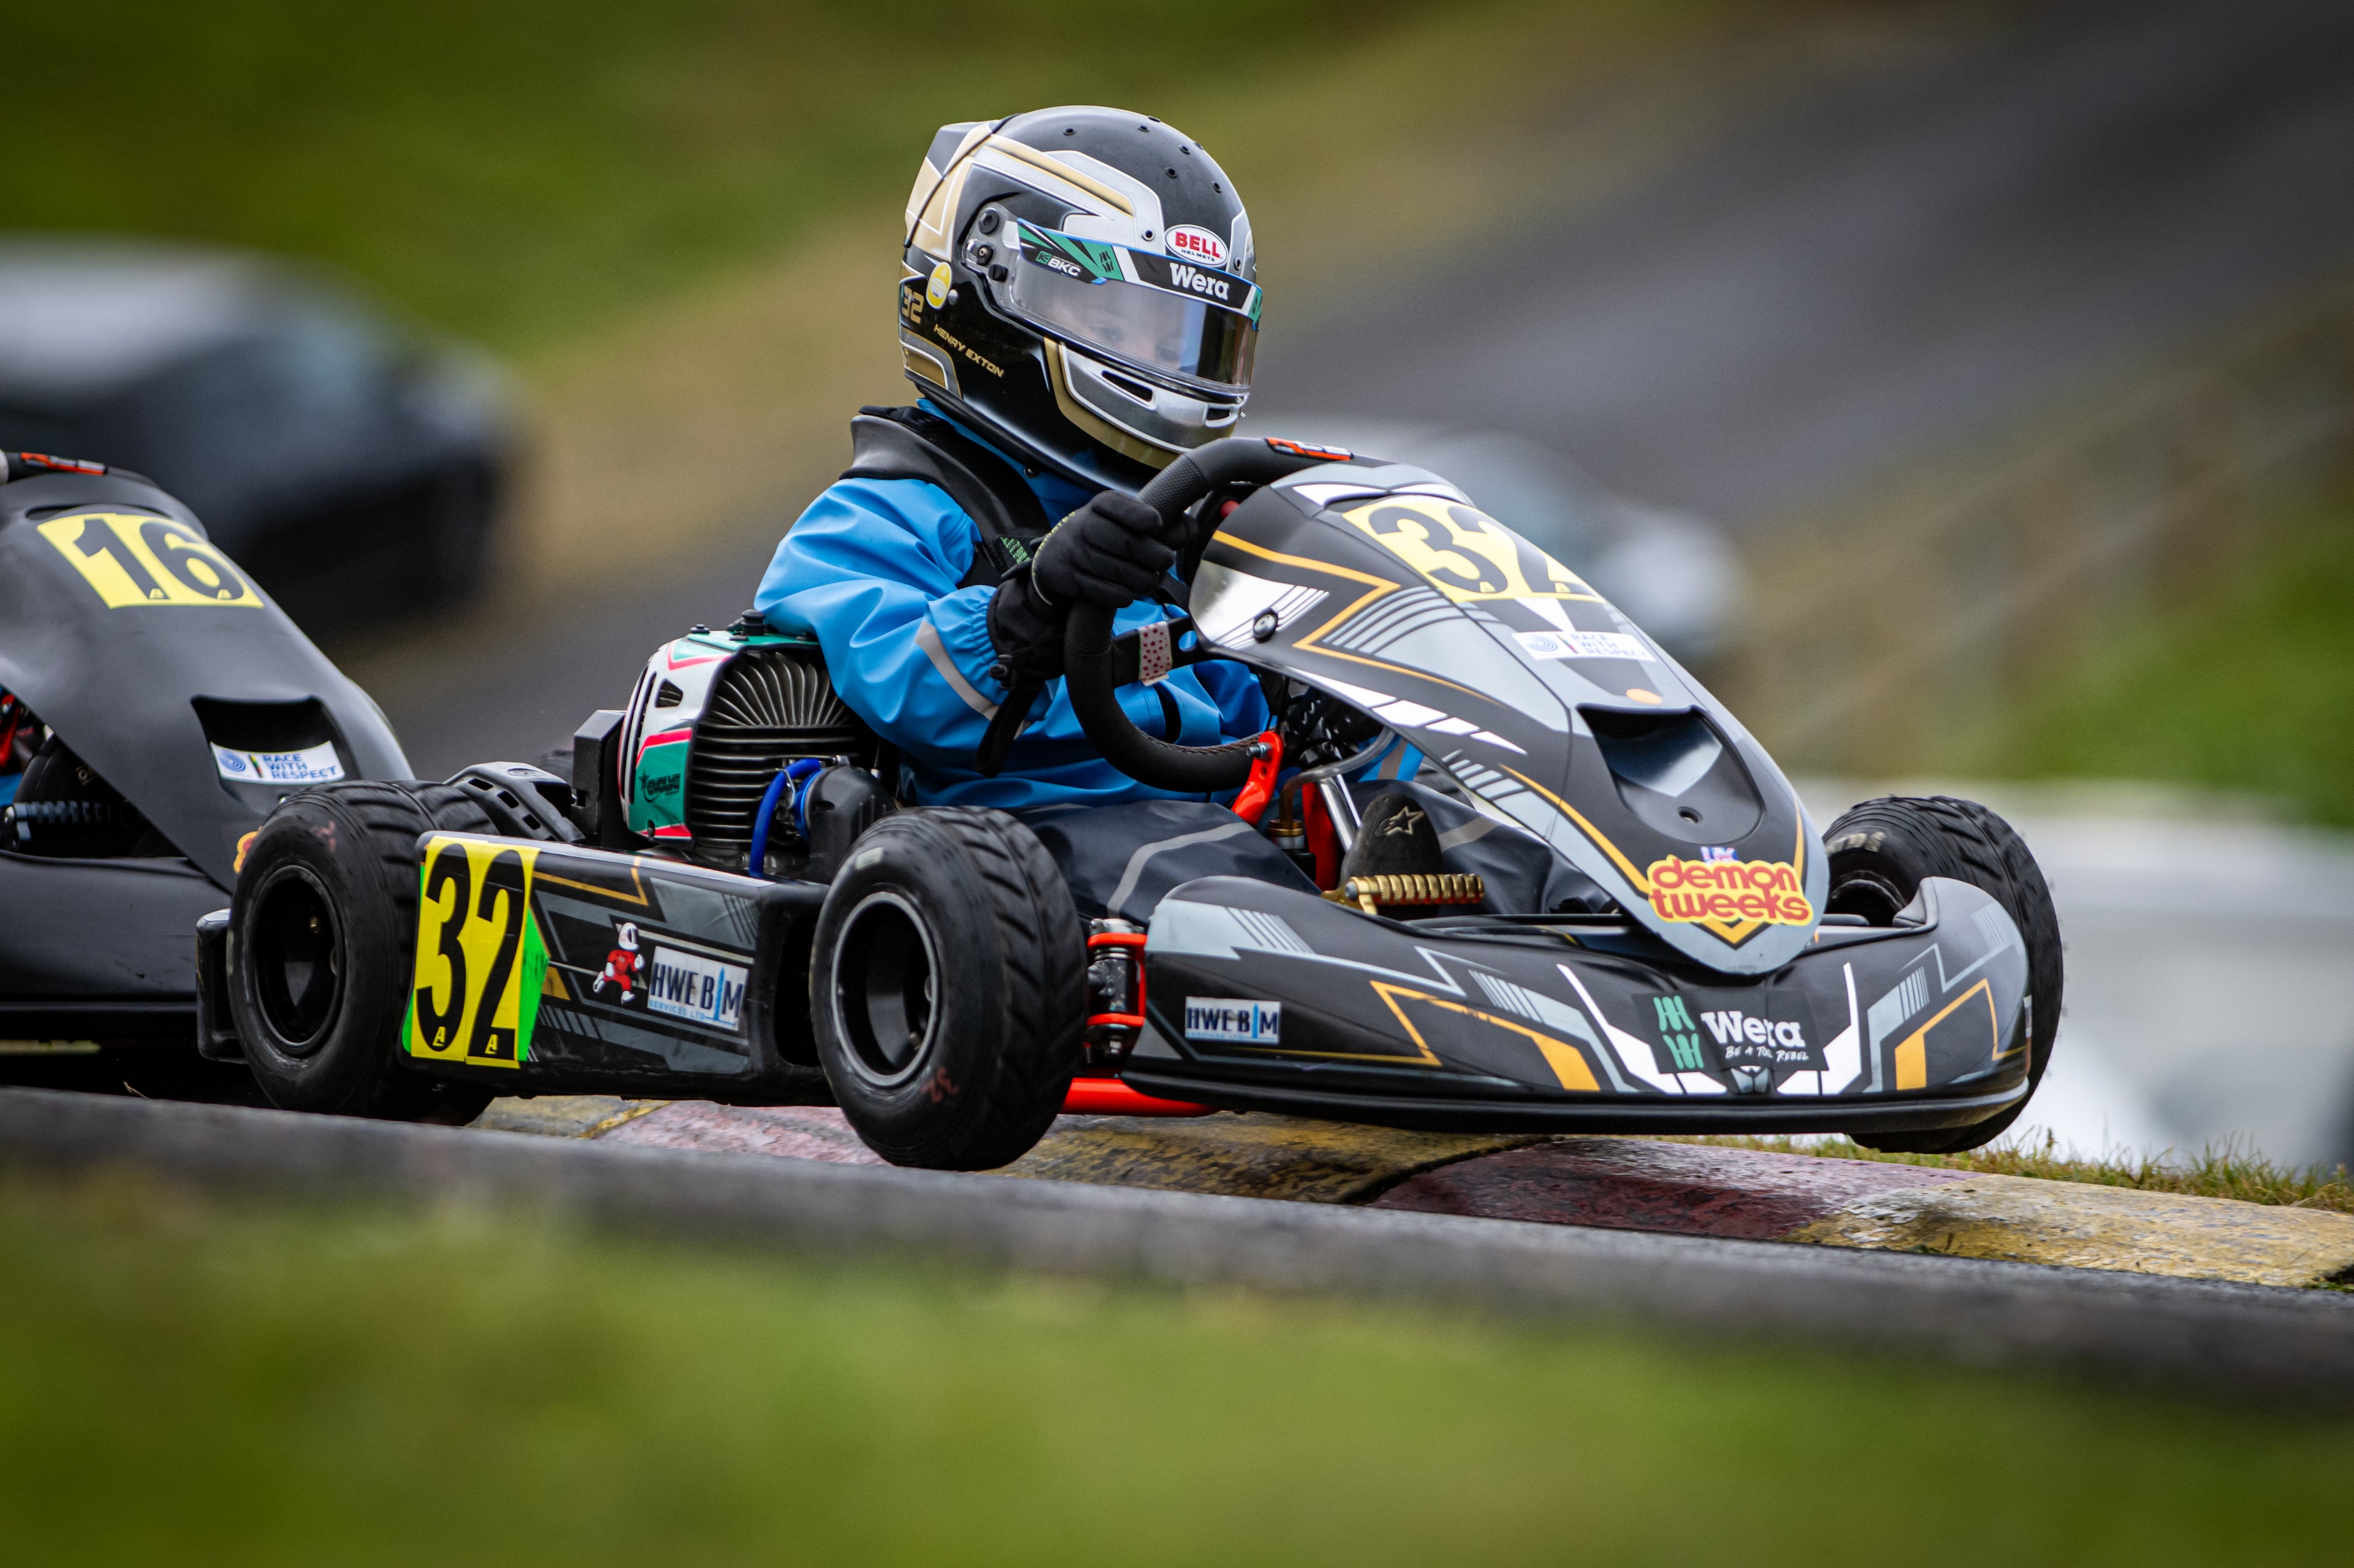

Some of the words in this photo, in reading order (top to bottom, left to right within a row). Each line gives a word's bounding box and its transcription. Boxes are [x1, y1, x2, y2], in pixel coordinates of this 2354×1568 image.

[1175, 231, 1221, 258] BELL
[1181, 249, 1215, 262] HELMETS
[1047, 257, 1081, 277] BKC
[1169, 262, 1230, 300] Wera
[902, 285, 924, 324] 32
[933, 324, 967, 352] HENRY
[965, 348, 1005, 378] EXTON
[72, 519, 244, 600] 16
[1368, 506, 1595, 594] 32
[262, 753, 302, 763] RACE
[268, 762, 308, 771] WITH
[272, 765, 337, 779] RESPECT
[1652, 858, 1799, 892] demon
[1650, 887, 1809, 920] tweeks
[416, 842, 525, 1060] 32
[650, 962, 699, 1006] HWE
[649, 1000, 687, 1016] SERVICES
[690, 1010, 705, 1020] LTD
[1186, 1007, 1232, 1031] HWE
[1700, 1011, 1806, 1048] Wera
[1725, 1045, 1742, 1059] BE
[1745, 1045, 1753, 1056] A
[1776, 1049, 1809, 1063] REBEL
